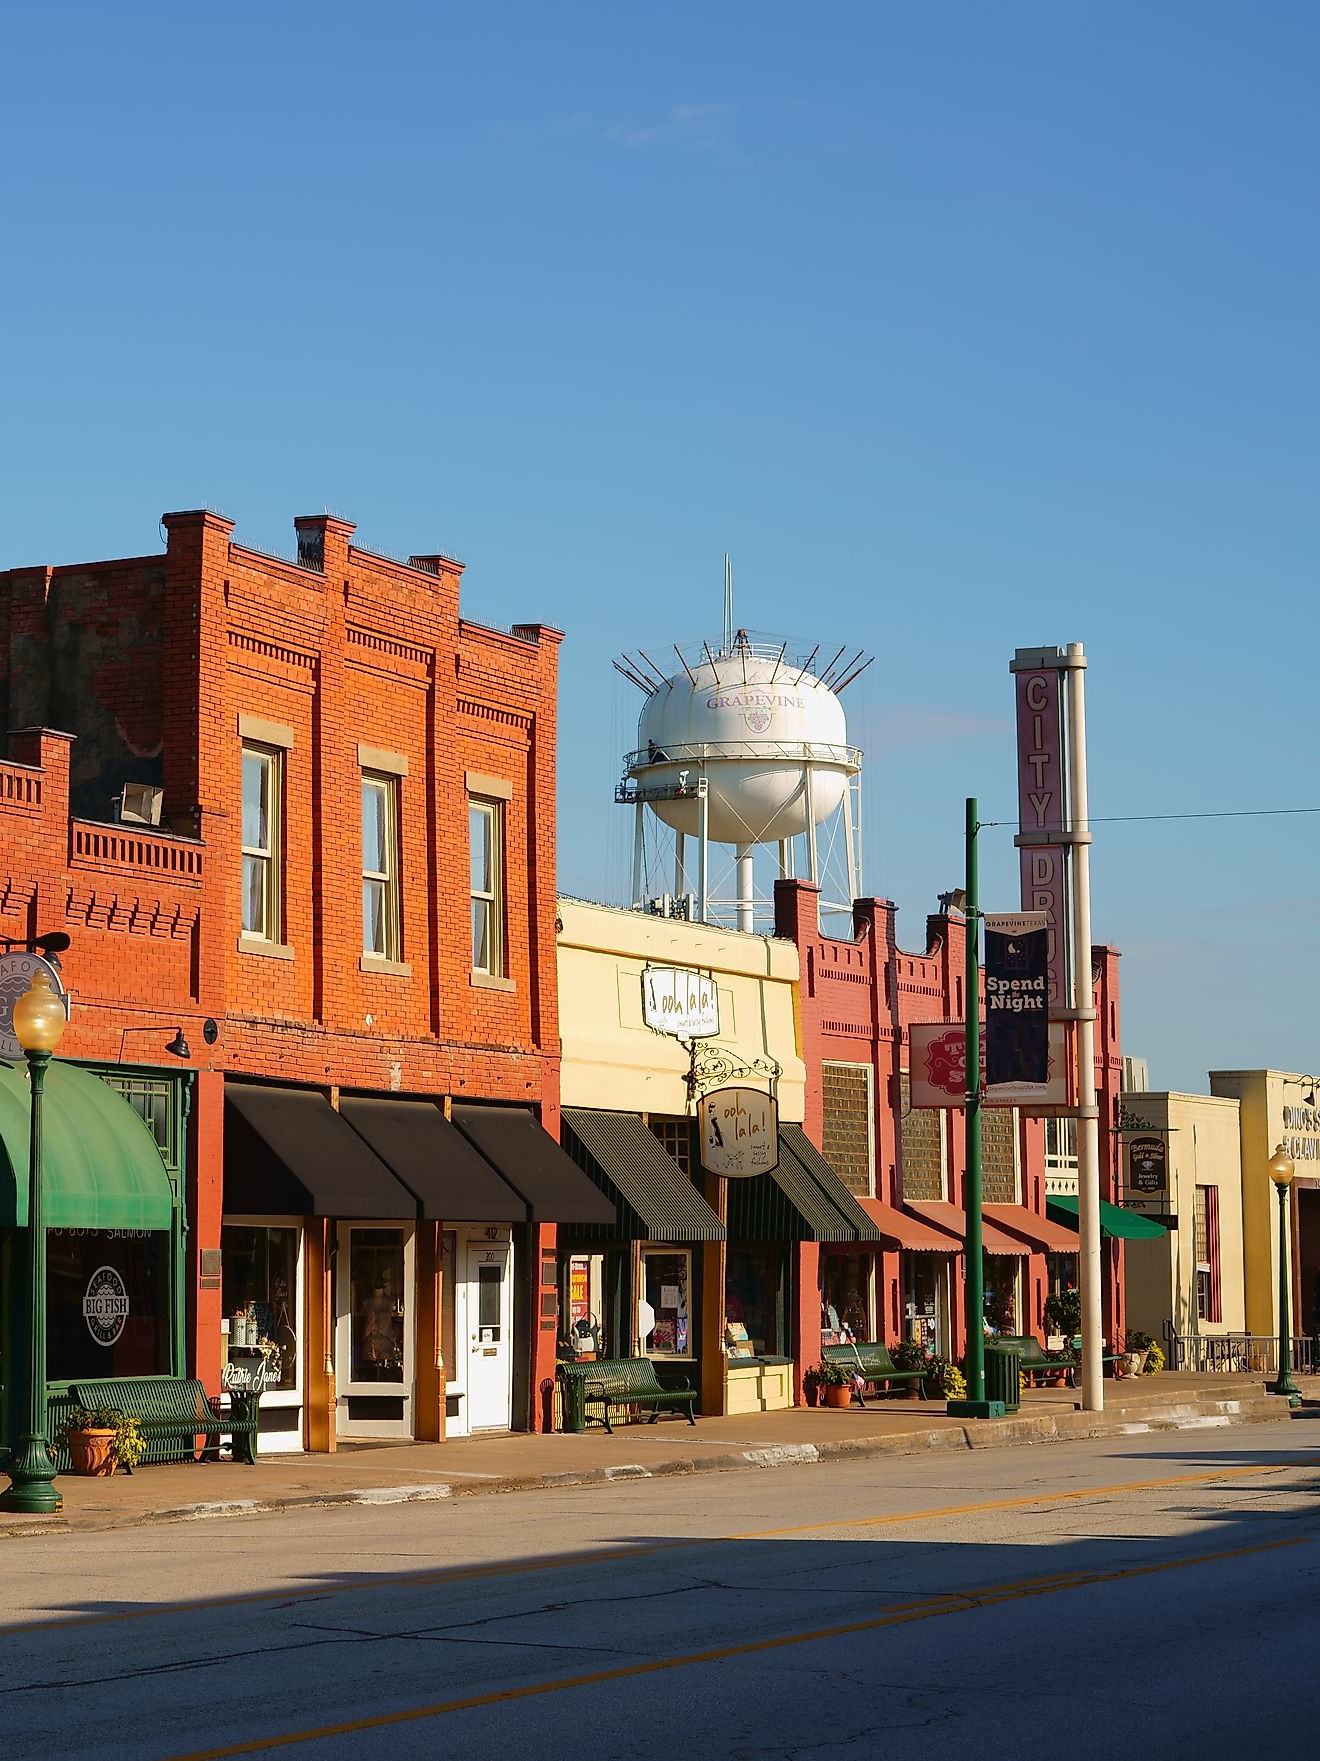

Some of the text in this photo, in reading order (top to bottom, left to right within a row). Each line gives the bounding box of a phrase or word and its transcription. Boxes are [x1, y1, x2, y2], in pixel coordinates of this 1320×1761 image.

[706, 694, 804, 710] GRAPEVINE
[1026, 675, 1052, 828] CITY
[986, 976, 1046, 995] Spend
[990, 995, 1043, 1012] Night
[724, 1092, 746, 1118] ooh
[1131, 1143, 1164, 1153] Bermuda
[1138, 1173, 1159, 1181] Jewelry
[107, 1229, 152, 1240] SALMON
[90, 1272, 122, 1296] SEAFOOD
[86, 1298, 126, 1314] BIG FISH
[222, 1362, 252, 1389] Ruthie
